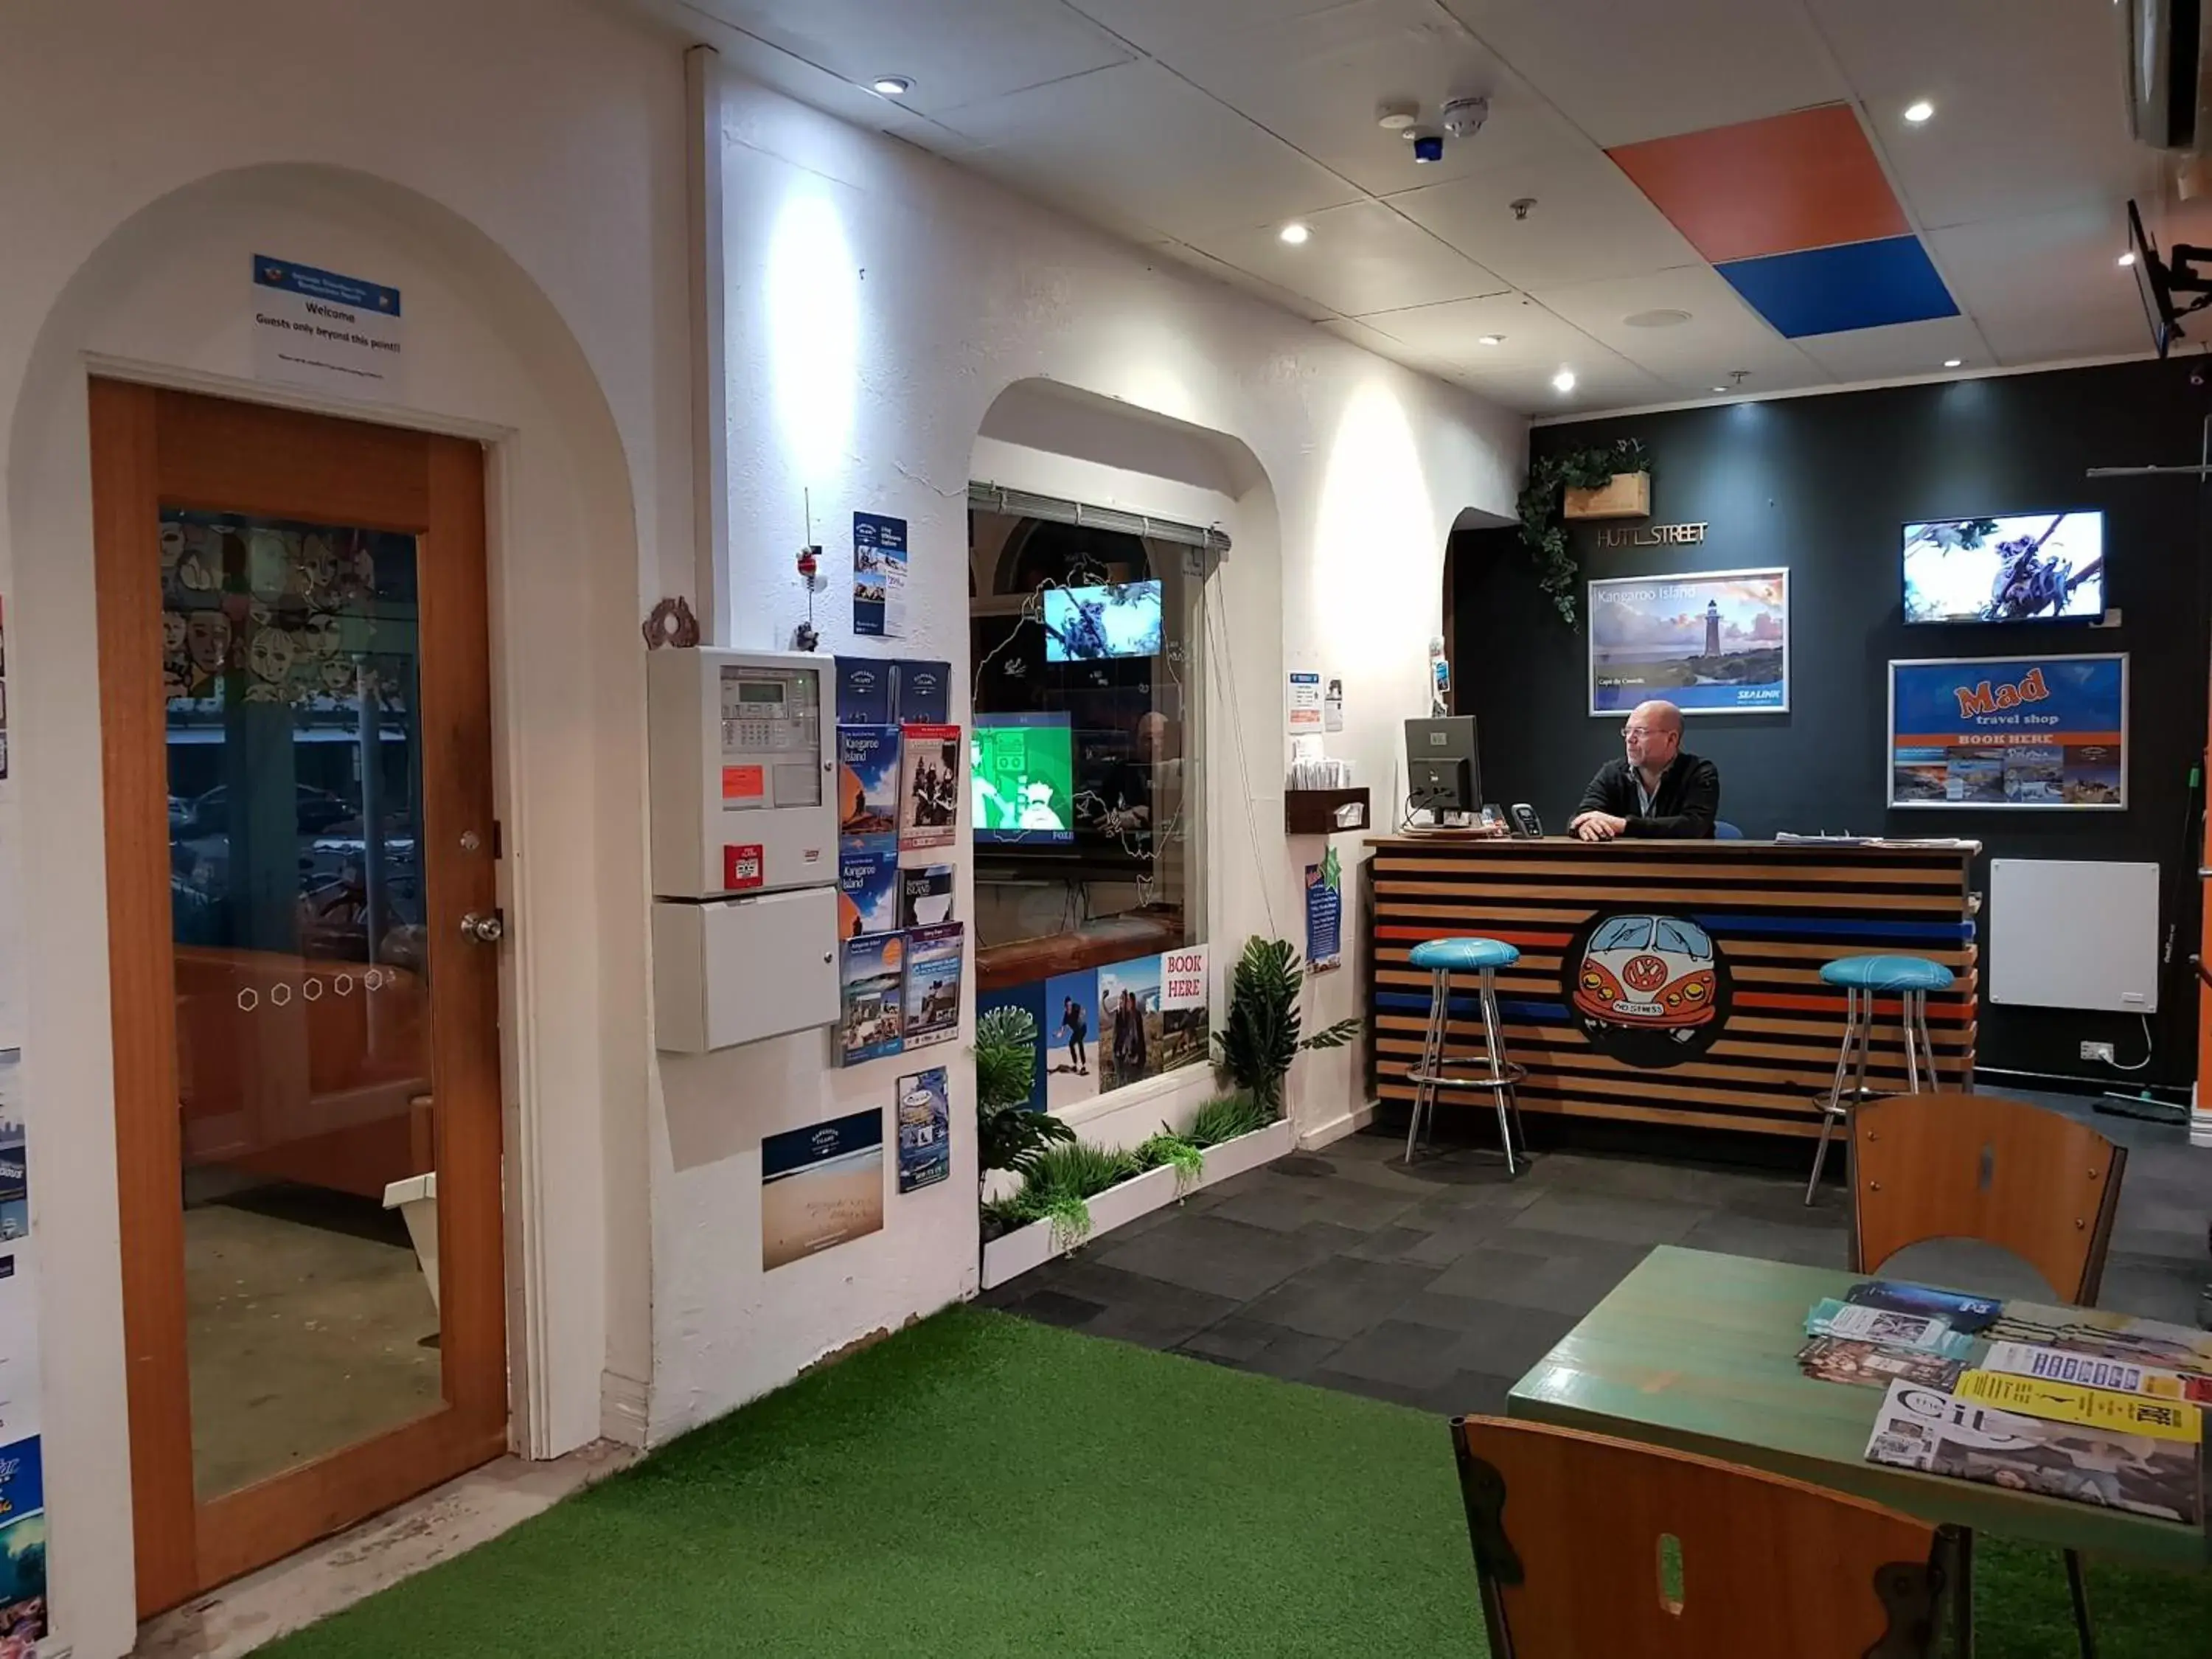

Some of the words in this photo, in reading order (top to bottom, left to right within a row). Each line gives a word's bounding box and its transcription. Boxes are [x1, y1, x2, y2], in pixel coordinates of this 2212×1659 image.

[305, 302, 355, 324] Welcome
[256, 313, 291, 329] Guests
[293, 321, 313, 335] only
[316, 326, 349, 343] beyond
[352, 335, 369, 347] this
[1651, 522, 1708, 546] STREET
[1598, 589, 1656, 603] Kangaroo
[1659, 585, 1696, 599] Island
[1737, 690, 1781, 700] SEALINK
[1955, 667, 2050, 719] Mad
[1977, 714, 2020, 725] travel
[2024, 714, 2060, 726] shop
[846, 739, 880, 751] Kangaroo
[1958, 735, 2006, 745] BOOK
[2008, 734, 2053, 744] HERE
[845, 751, 866, 762] Island
[844, 866, 876, 878] Kangaroo
[844, 877, 863, 888] Island
[1167, 955, 1202, 973] BOOK
[1168, 979, 1200, 998] HERE
